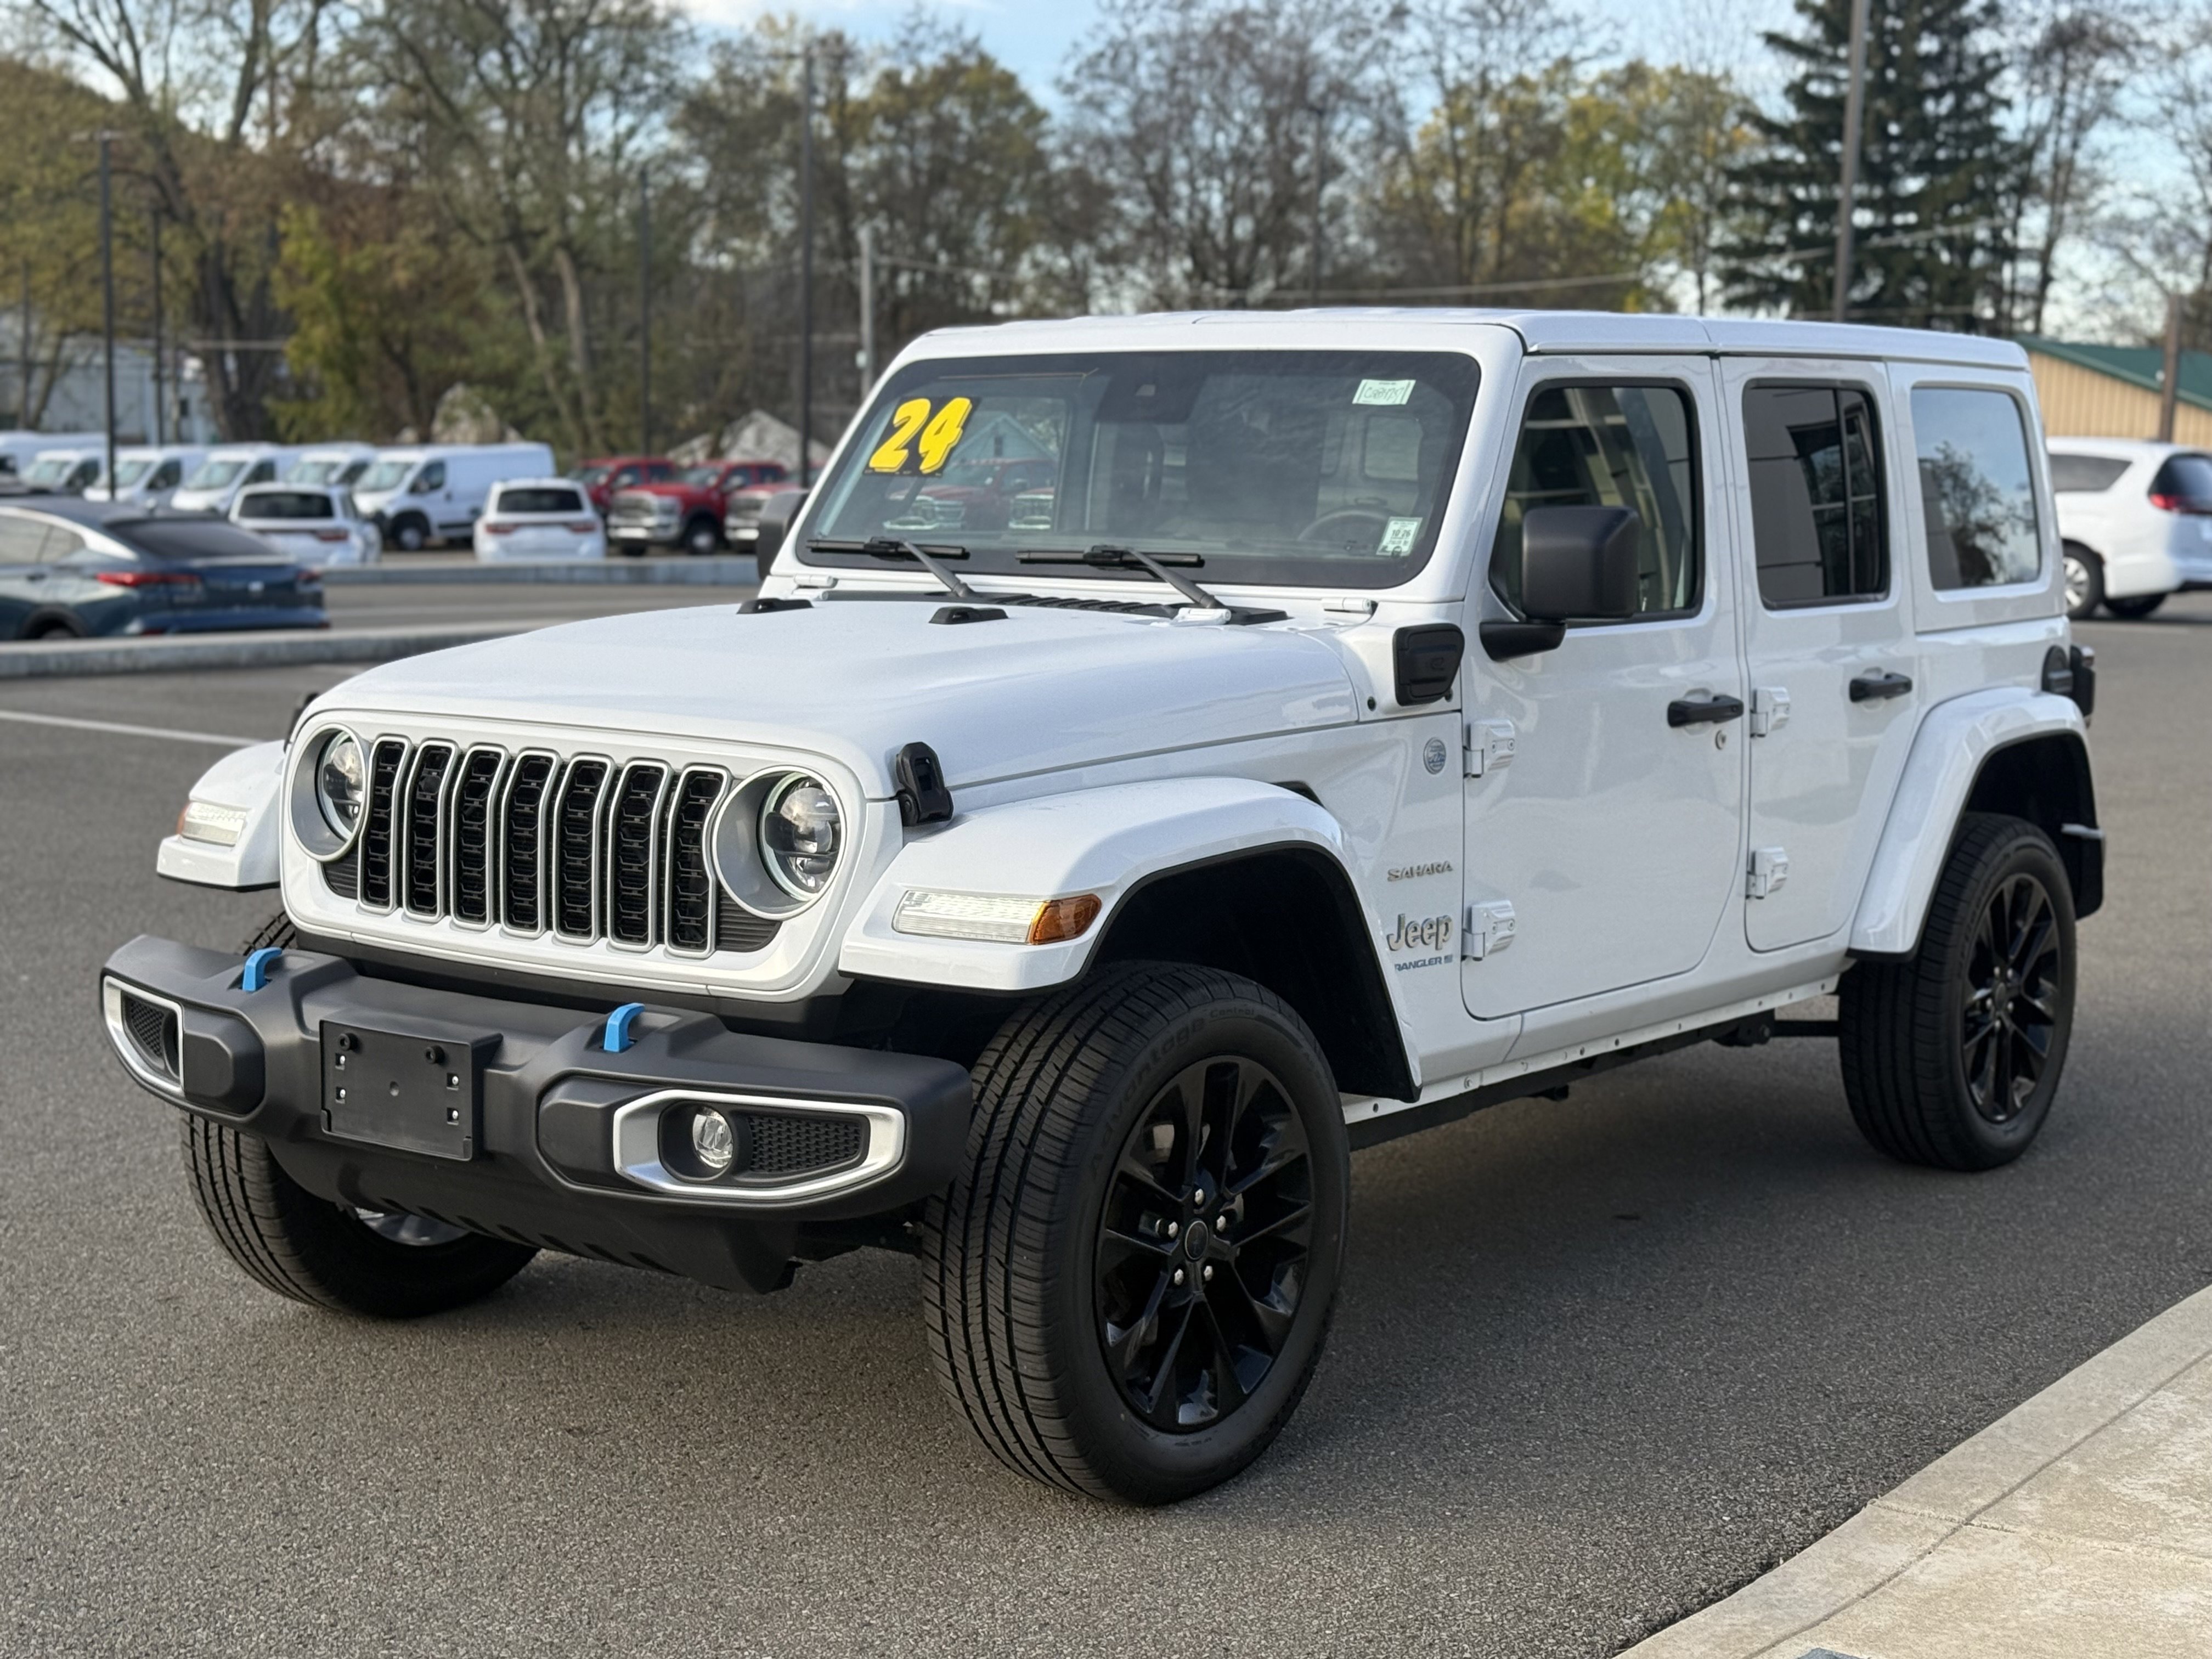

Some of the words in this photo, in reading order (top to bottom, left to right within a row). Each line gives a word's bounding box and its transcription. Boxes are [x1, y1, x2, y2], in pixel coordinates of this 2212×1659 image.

[868, 397, 972, 474] 24
[1387, 860, 1453, 882] SAHARA
[1386, 913, 1452, 951] Jeep
